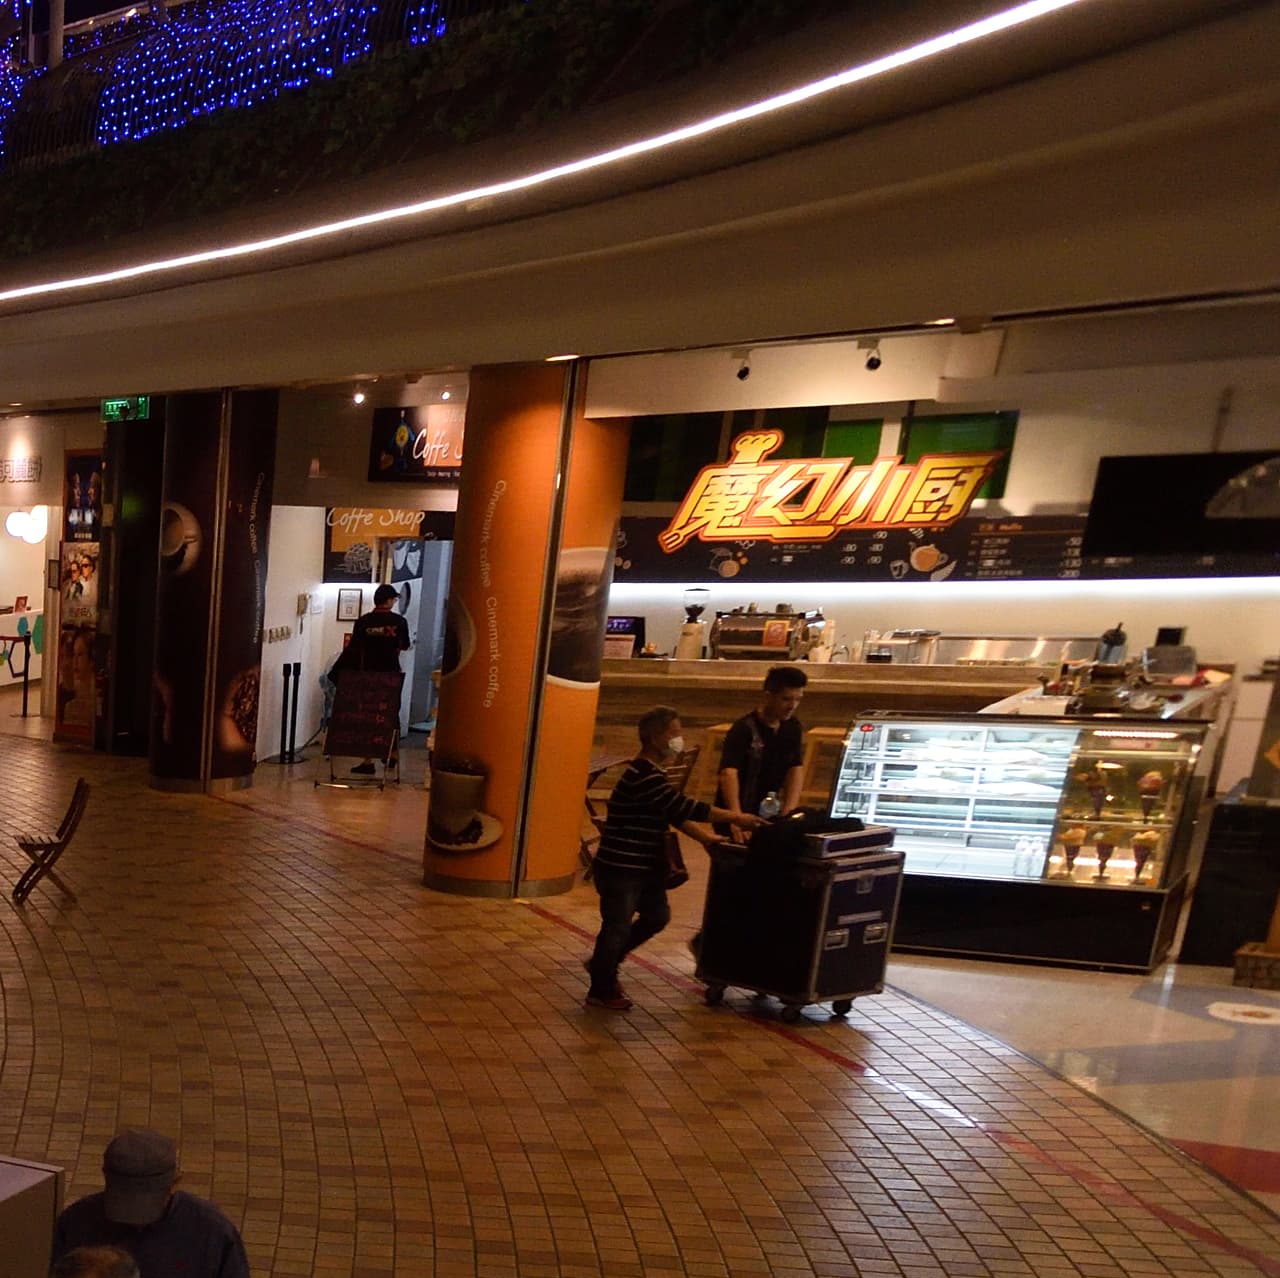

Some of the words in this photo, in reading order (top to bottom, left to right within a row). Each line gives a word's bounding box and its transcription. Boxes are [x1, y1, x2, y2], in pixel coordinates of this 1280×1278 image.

[412, 428, 450, 465] Coffe
[326, 507, 373, 533] Coffe
[379, 507, 426, 530] Shop
[481, 479, 507, 544] Cinemark
[480, 547, 492, 588] coffee
[486, 597, 501, 663] Cinemark
[482, 665, 499, 709] coffee
